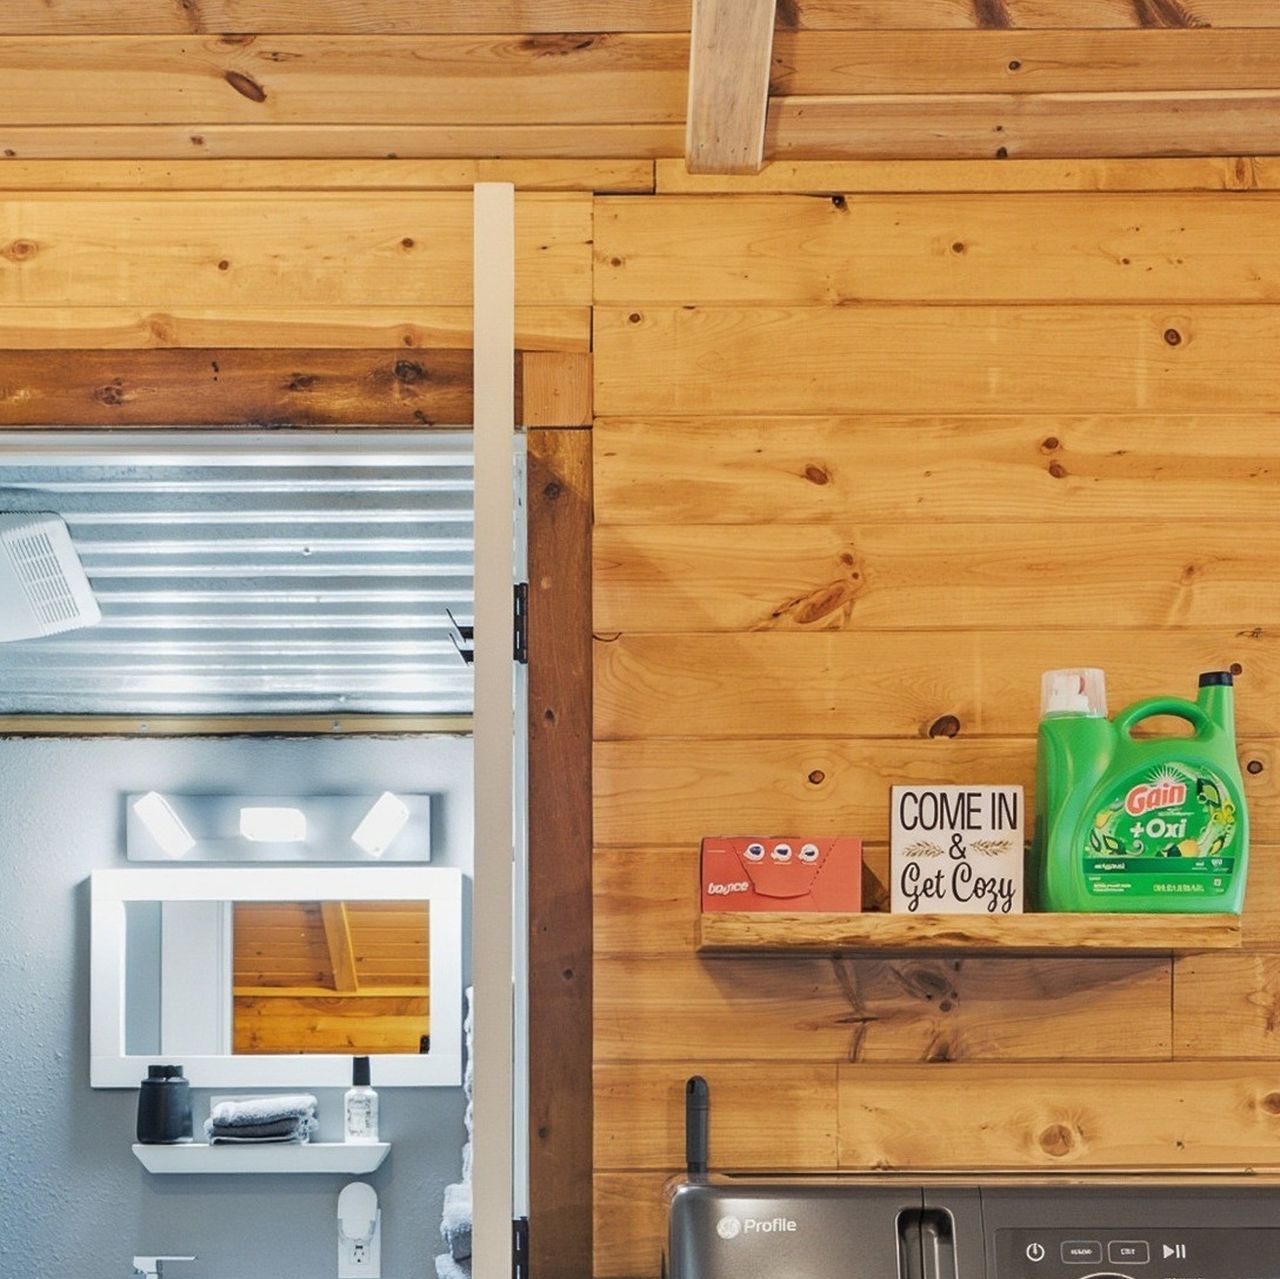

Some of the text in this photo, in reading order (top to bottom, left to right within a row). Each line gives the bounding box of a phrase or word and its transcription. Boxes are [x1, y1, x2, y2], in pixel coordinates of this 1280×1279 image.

[900, 791, 1017, 831] COME IN
[1125, 782, 1187, 817] Gain
[949, 833, 967, 860] &
[901, 862, 1016, 913] Get Cozy
[743, 1217, 797, 1234] Profile
